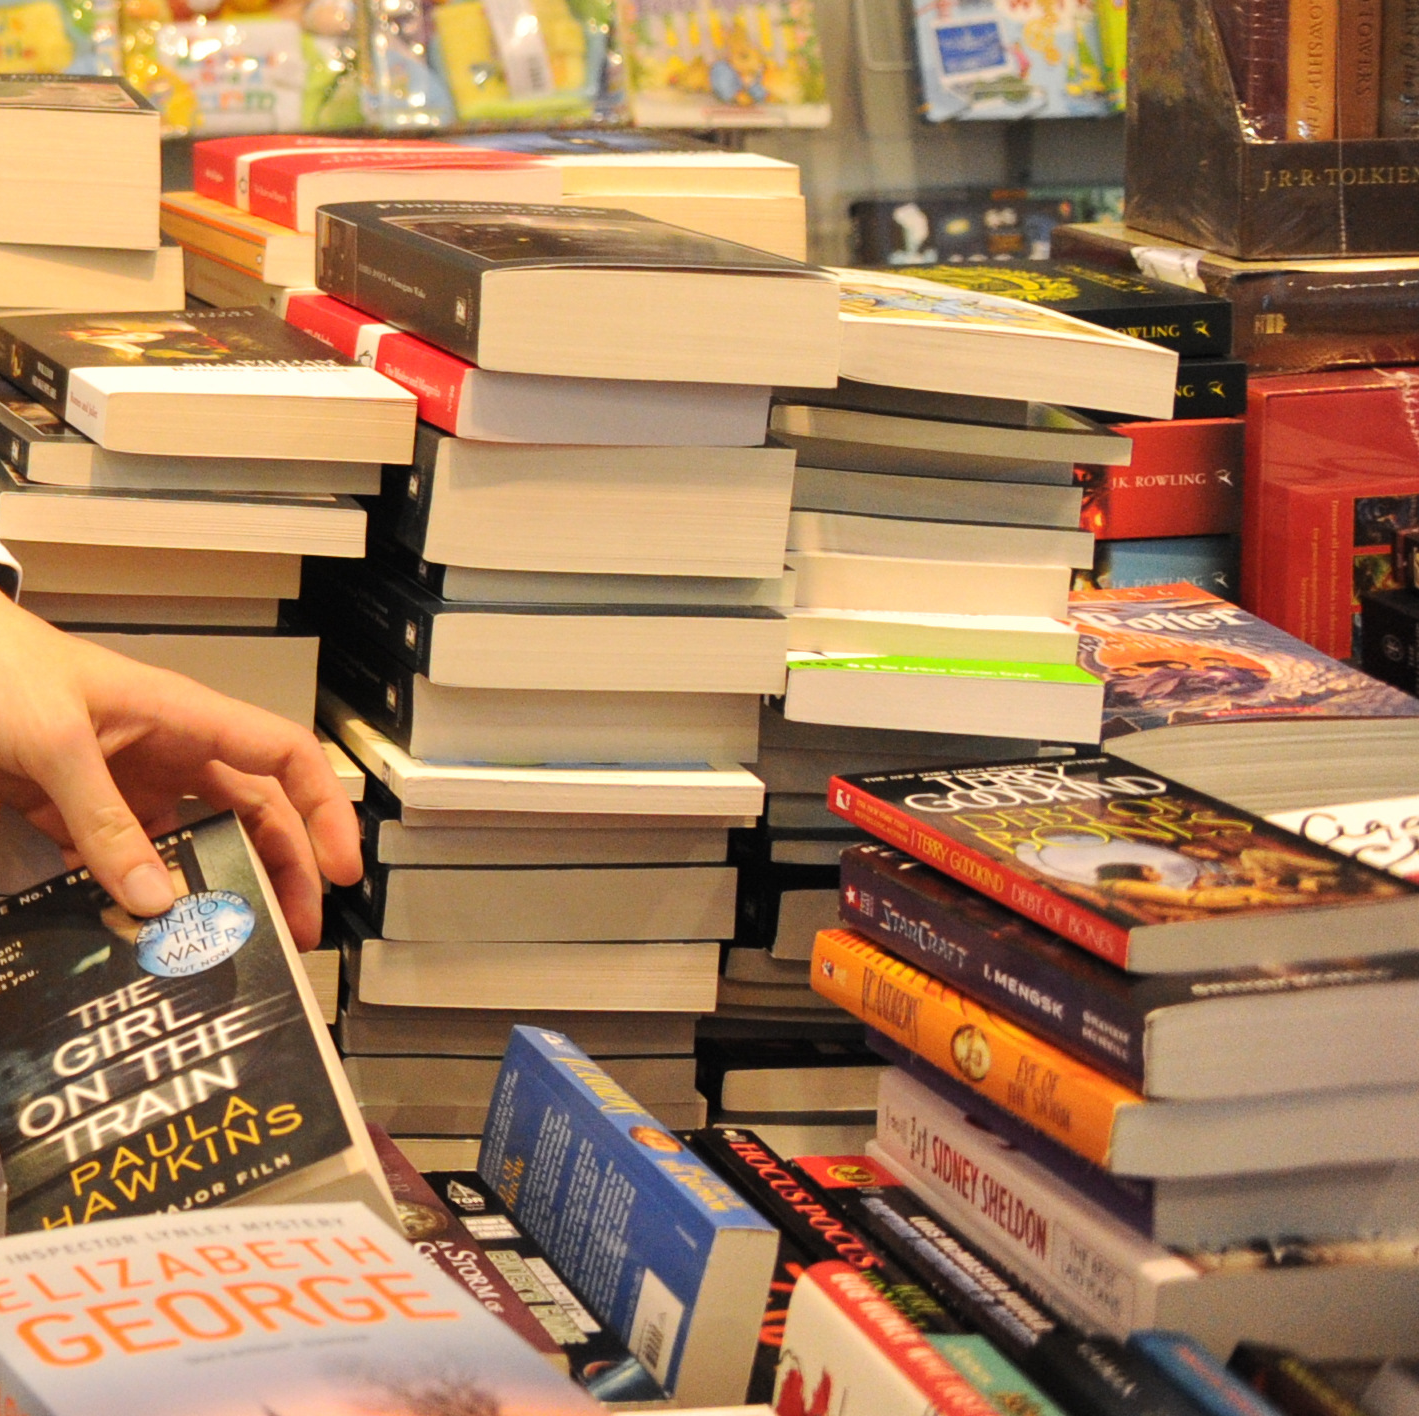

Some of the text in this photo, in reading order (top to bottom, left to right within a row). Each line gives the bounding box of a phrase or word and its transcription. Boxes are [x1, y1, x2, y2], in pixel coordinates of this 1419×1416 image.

[1134, 471, 1207, 487] ROWLING
[903, 774, 1169, 814] GOODKIND
[921, 765, 1071, 795] TERRY
[974, 810, 1255, 855] BONES
[158, 898, 220, 934] INTO
[916, 829, 1117, 956] TERRY GOODKIND DEBT BONES
[156, 925, 239, 968] WATER
[172, 918, 215, 944] THE
[68, 975, 165, 1030] THE
[993, 966, 1066, 1022] MENGSK
[52, 997, 205, 1078] GIRL
[17, 1004, 264, 1139] ON THE
[46, 1054, 240, 1164] TRAIN
[41, 1103, 305, 1232] HAWKINS
[68, 1095, 260, 1197] PAULA
[236, 1153, 293, 1187] FILM
[451, 1196, 486, 1208] TOR
[729, 1141, 805, 1212] HOCUS
[797, 1196, 886, 1271] POCUS
[930, 1134, 1049, 1260] SIDNEY SHELDON
[3, 1233, 138, 1269] INSPECTOR
[143, 1222, 235, 1248] LYNLEY
[242, 1214, 345, 1235] MYSTERY
[446, 1244, 500, 1304] STORM
[12, 1271, 463, 1369] GEORGE
